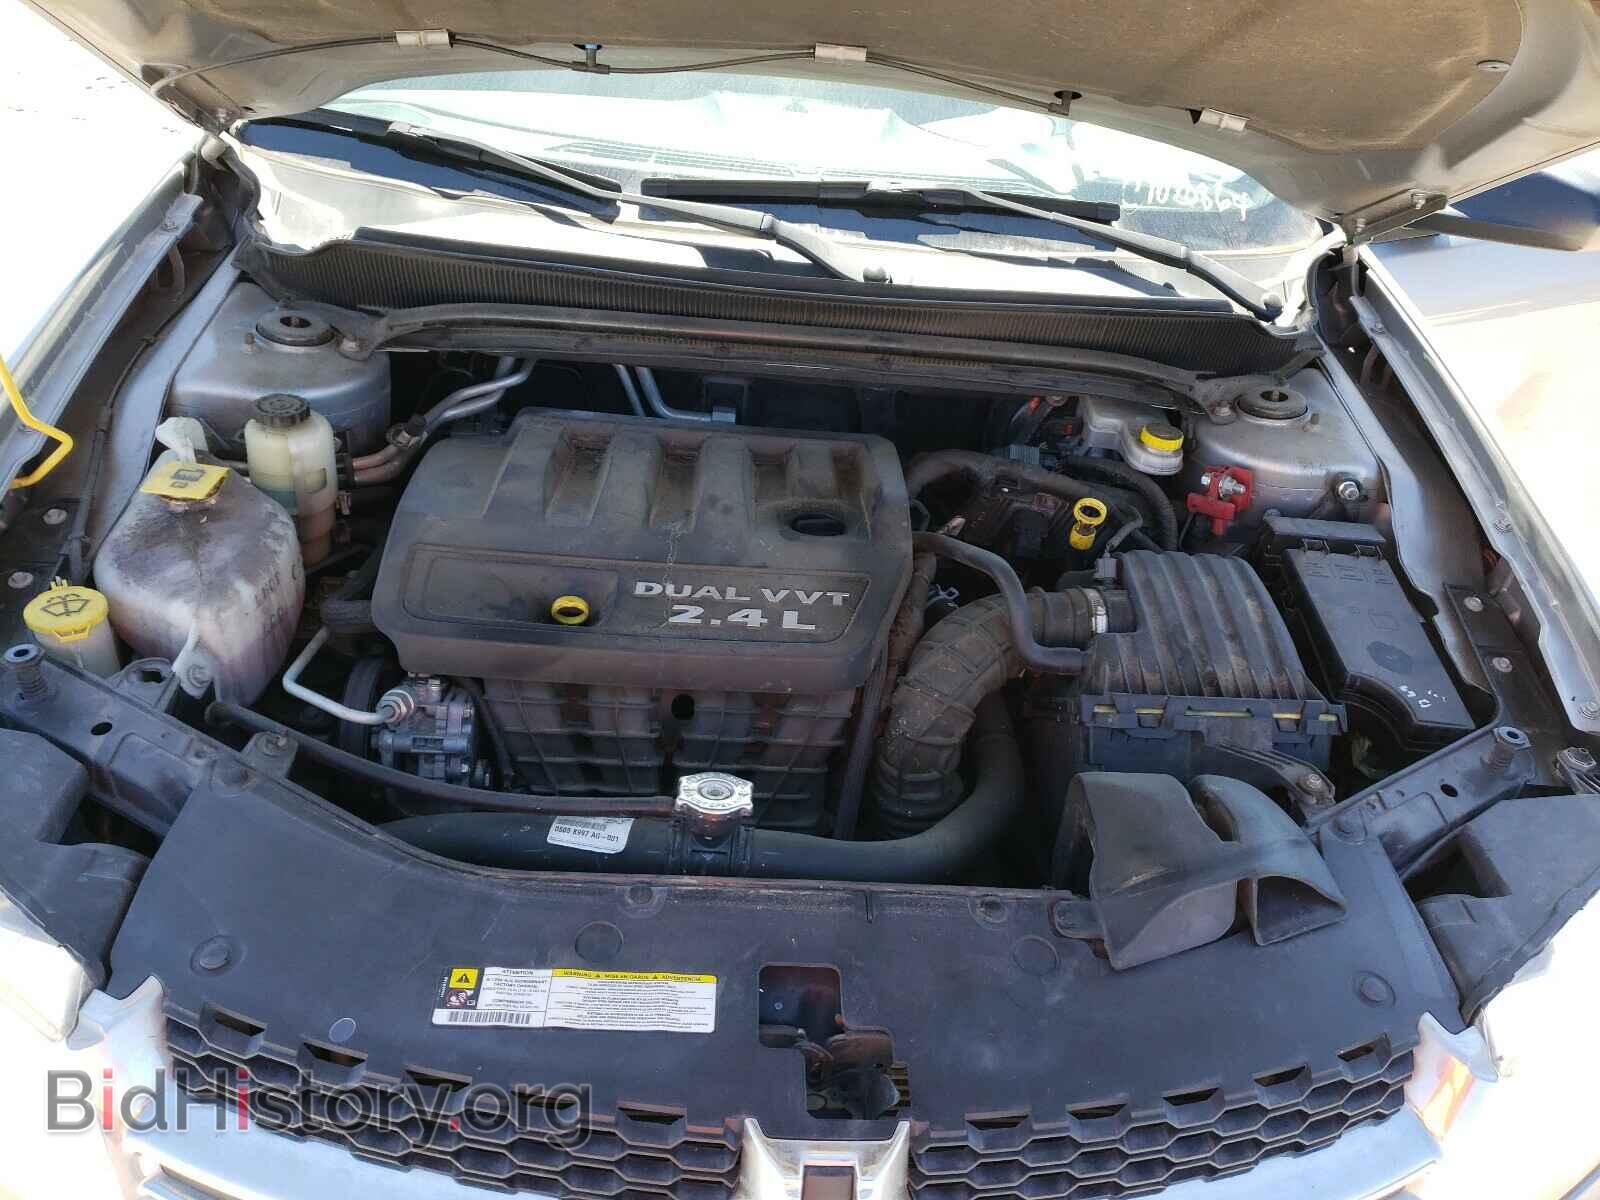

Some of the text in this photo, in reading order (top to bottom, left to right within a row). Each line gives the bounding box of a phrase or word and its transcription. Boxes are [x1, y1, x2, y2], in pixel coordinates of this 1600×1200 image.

[633, 581, 850, 606] DUAL VVT
[563, 970, 592, 978] WARNING
